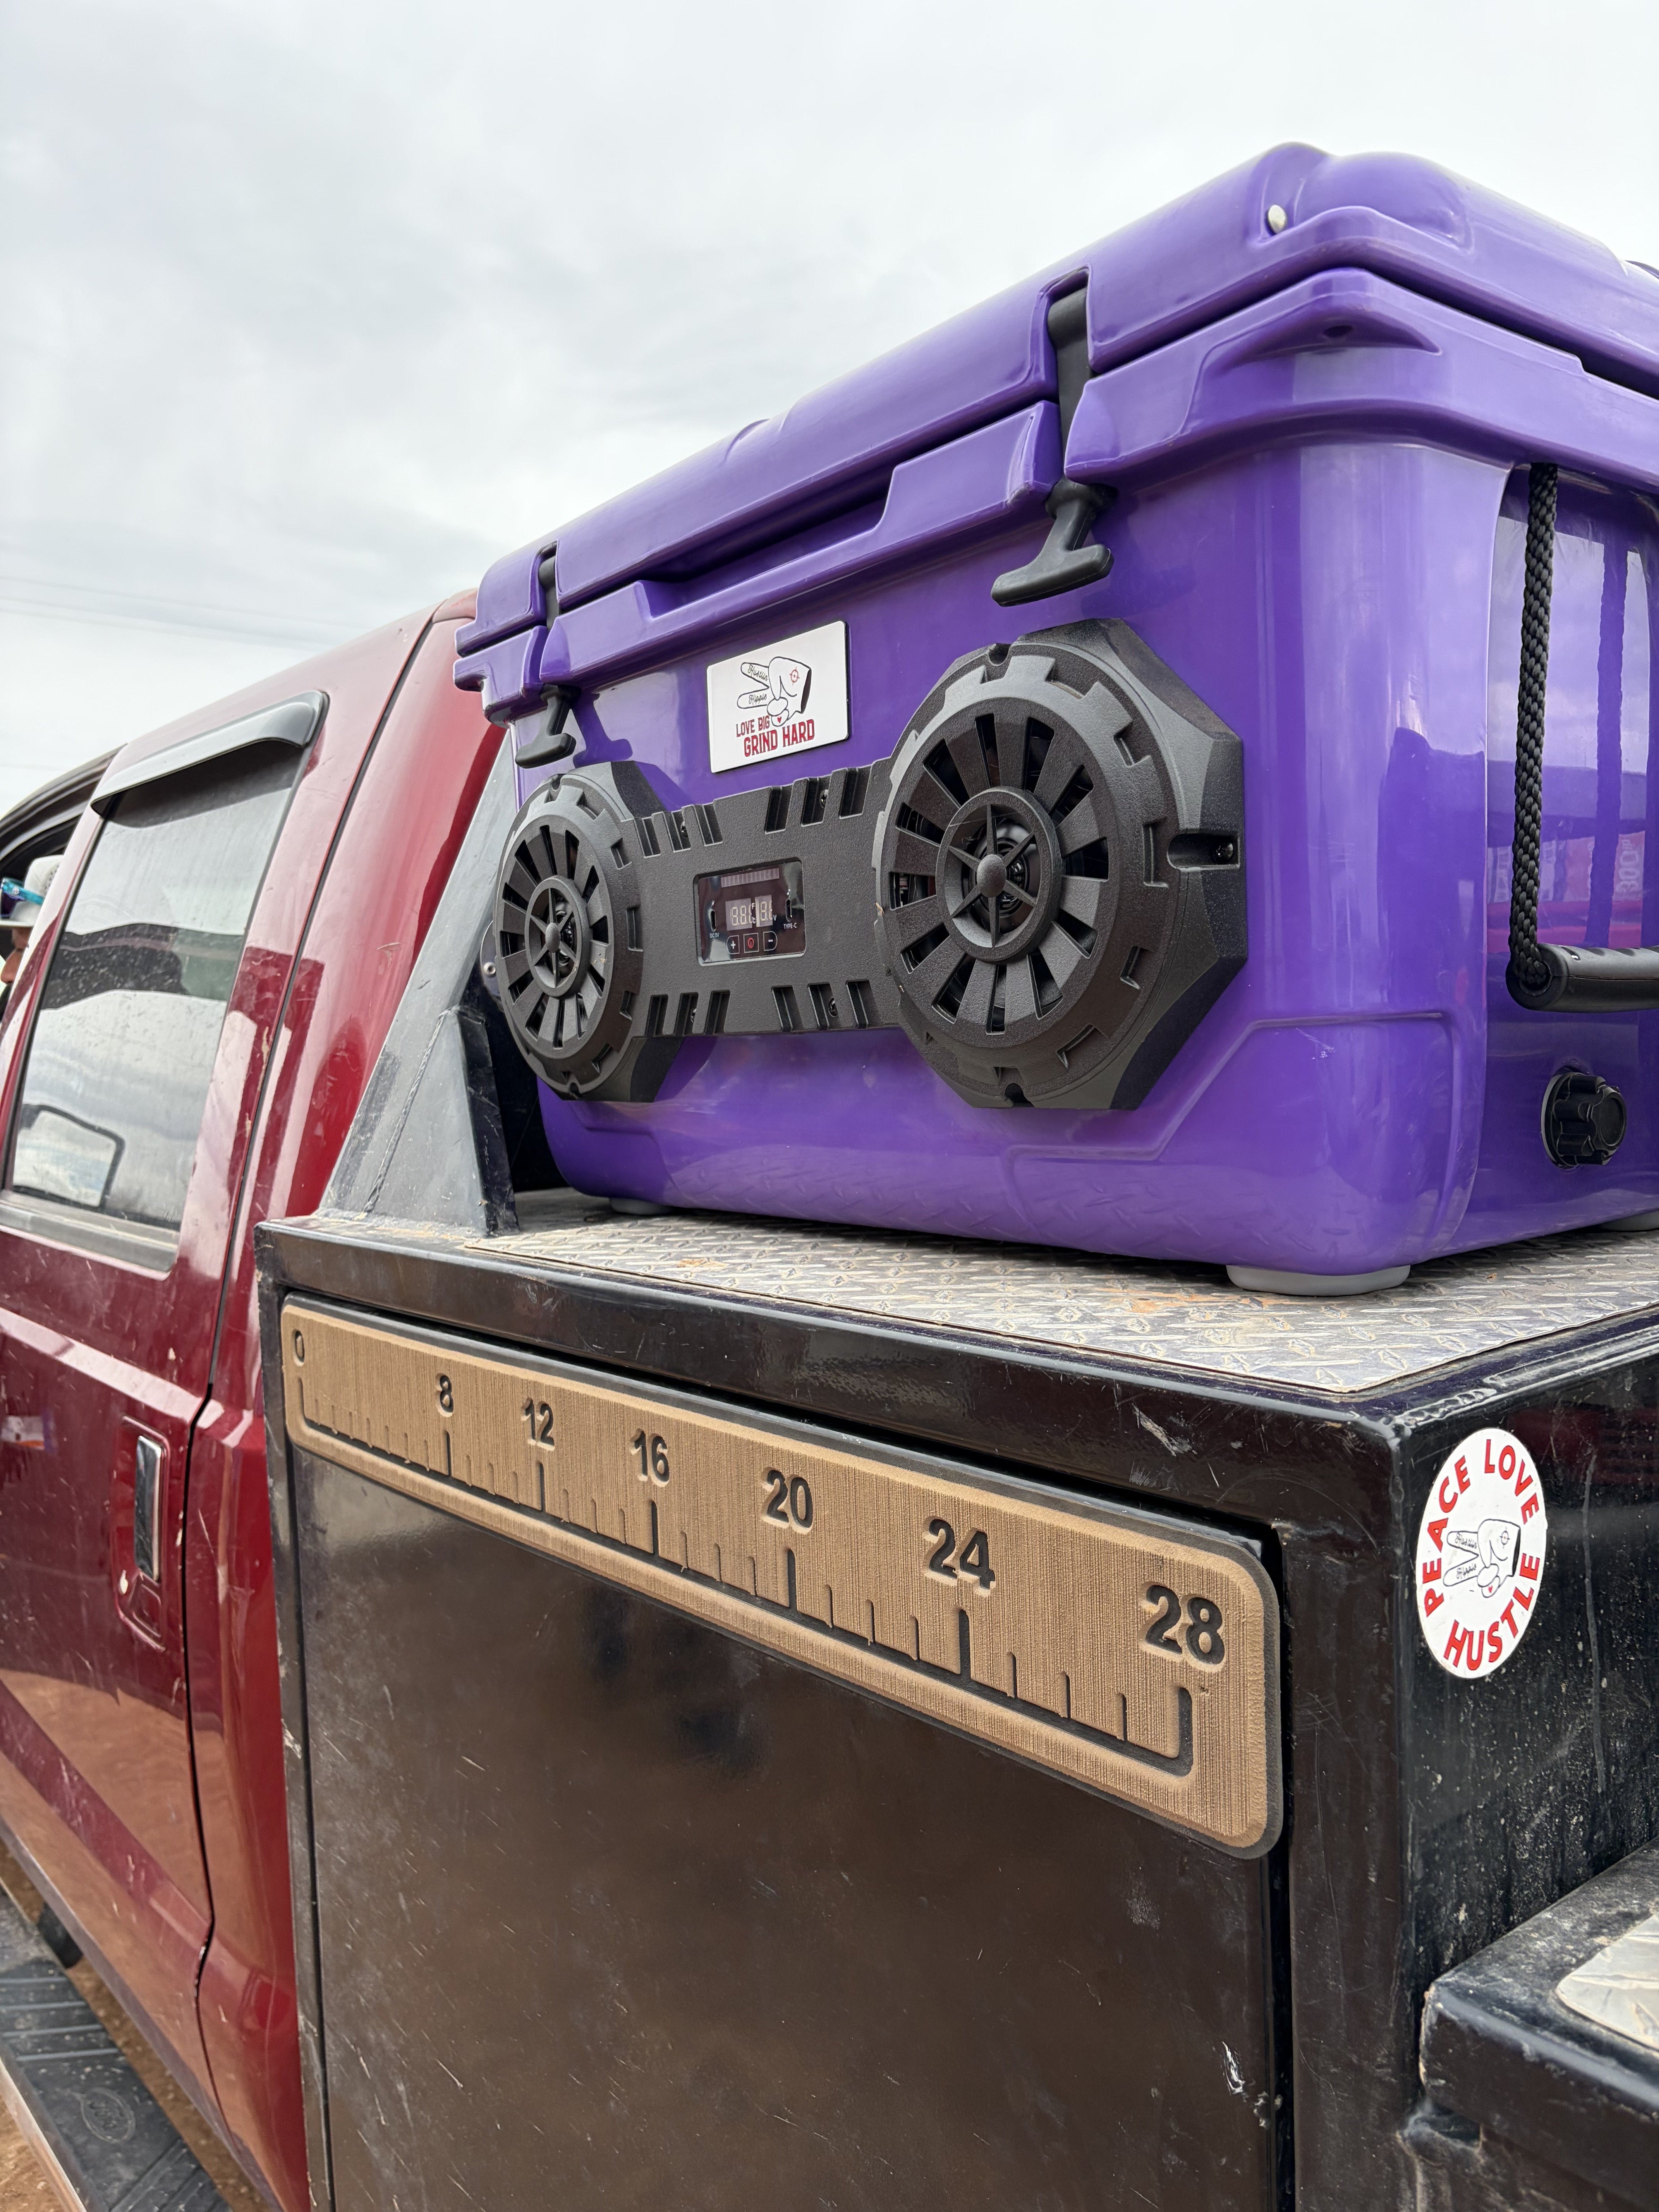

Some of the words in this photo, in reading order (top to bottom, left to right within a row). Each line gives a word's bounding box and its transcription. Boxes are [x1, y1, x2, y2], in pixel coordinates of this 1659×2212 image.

[736, 719, 755, 737] LOVE
[758, 715, 770, 731] BIG
[744, 730, 778, 757] GRIND
[782, 719, 815, 747] HARD
[292, 1329, 305, 1366] 0
[436, 1374, 454, 1418] 8
[521, 1397, 555, 1451] 12
[630, 1427, 670, 1487] 16
[761, 1467, 813, 1534] 20
[923, 1518, 996, 1595] 24
[1140, 1584, 1225, 1672] 28
[1422, 1455, 1471, 1617] PEACE
[1484, 1439, 1540, 1525] LOVE
[1443, 1553, 1540, 1671] HUSTLE
